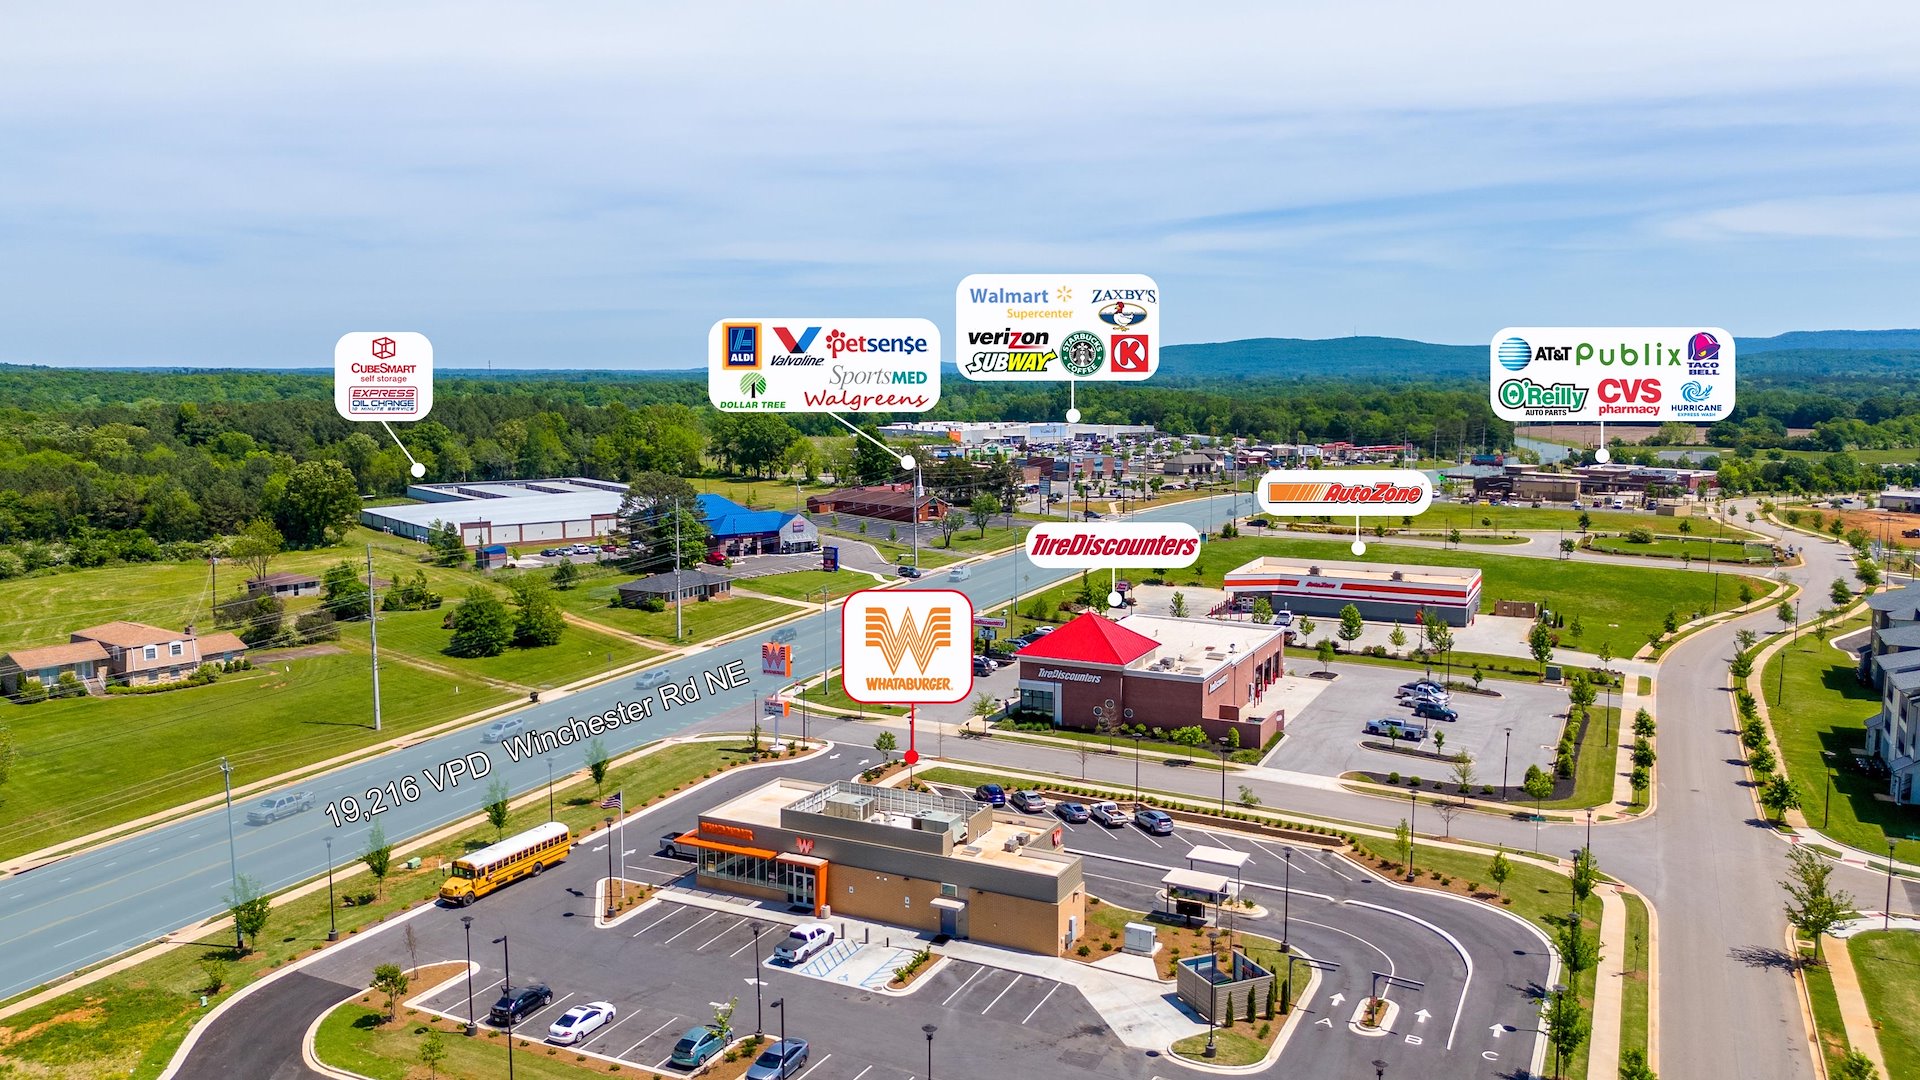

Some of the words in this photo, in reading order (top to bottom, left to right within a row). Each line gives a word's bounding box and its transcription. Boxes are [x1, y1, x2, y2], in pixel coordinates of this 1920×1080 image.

[1314, 1017, 1333, 1028] A
[1405, 1034, 1423, 1046] B
[1481, 1050, 1500, 1061] C
